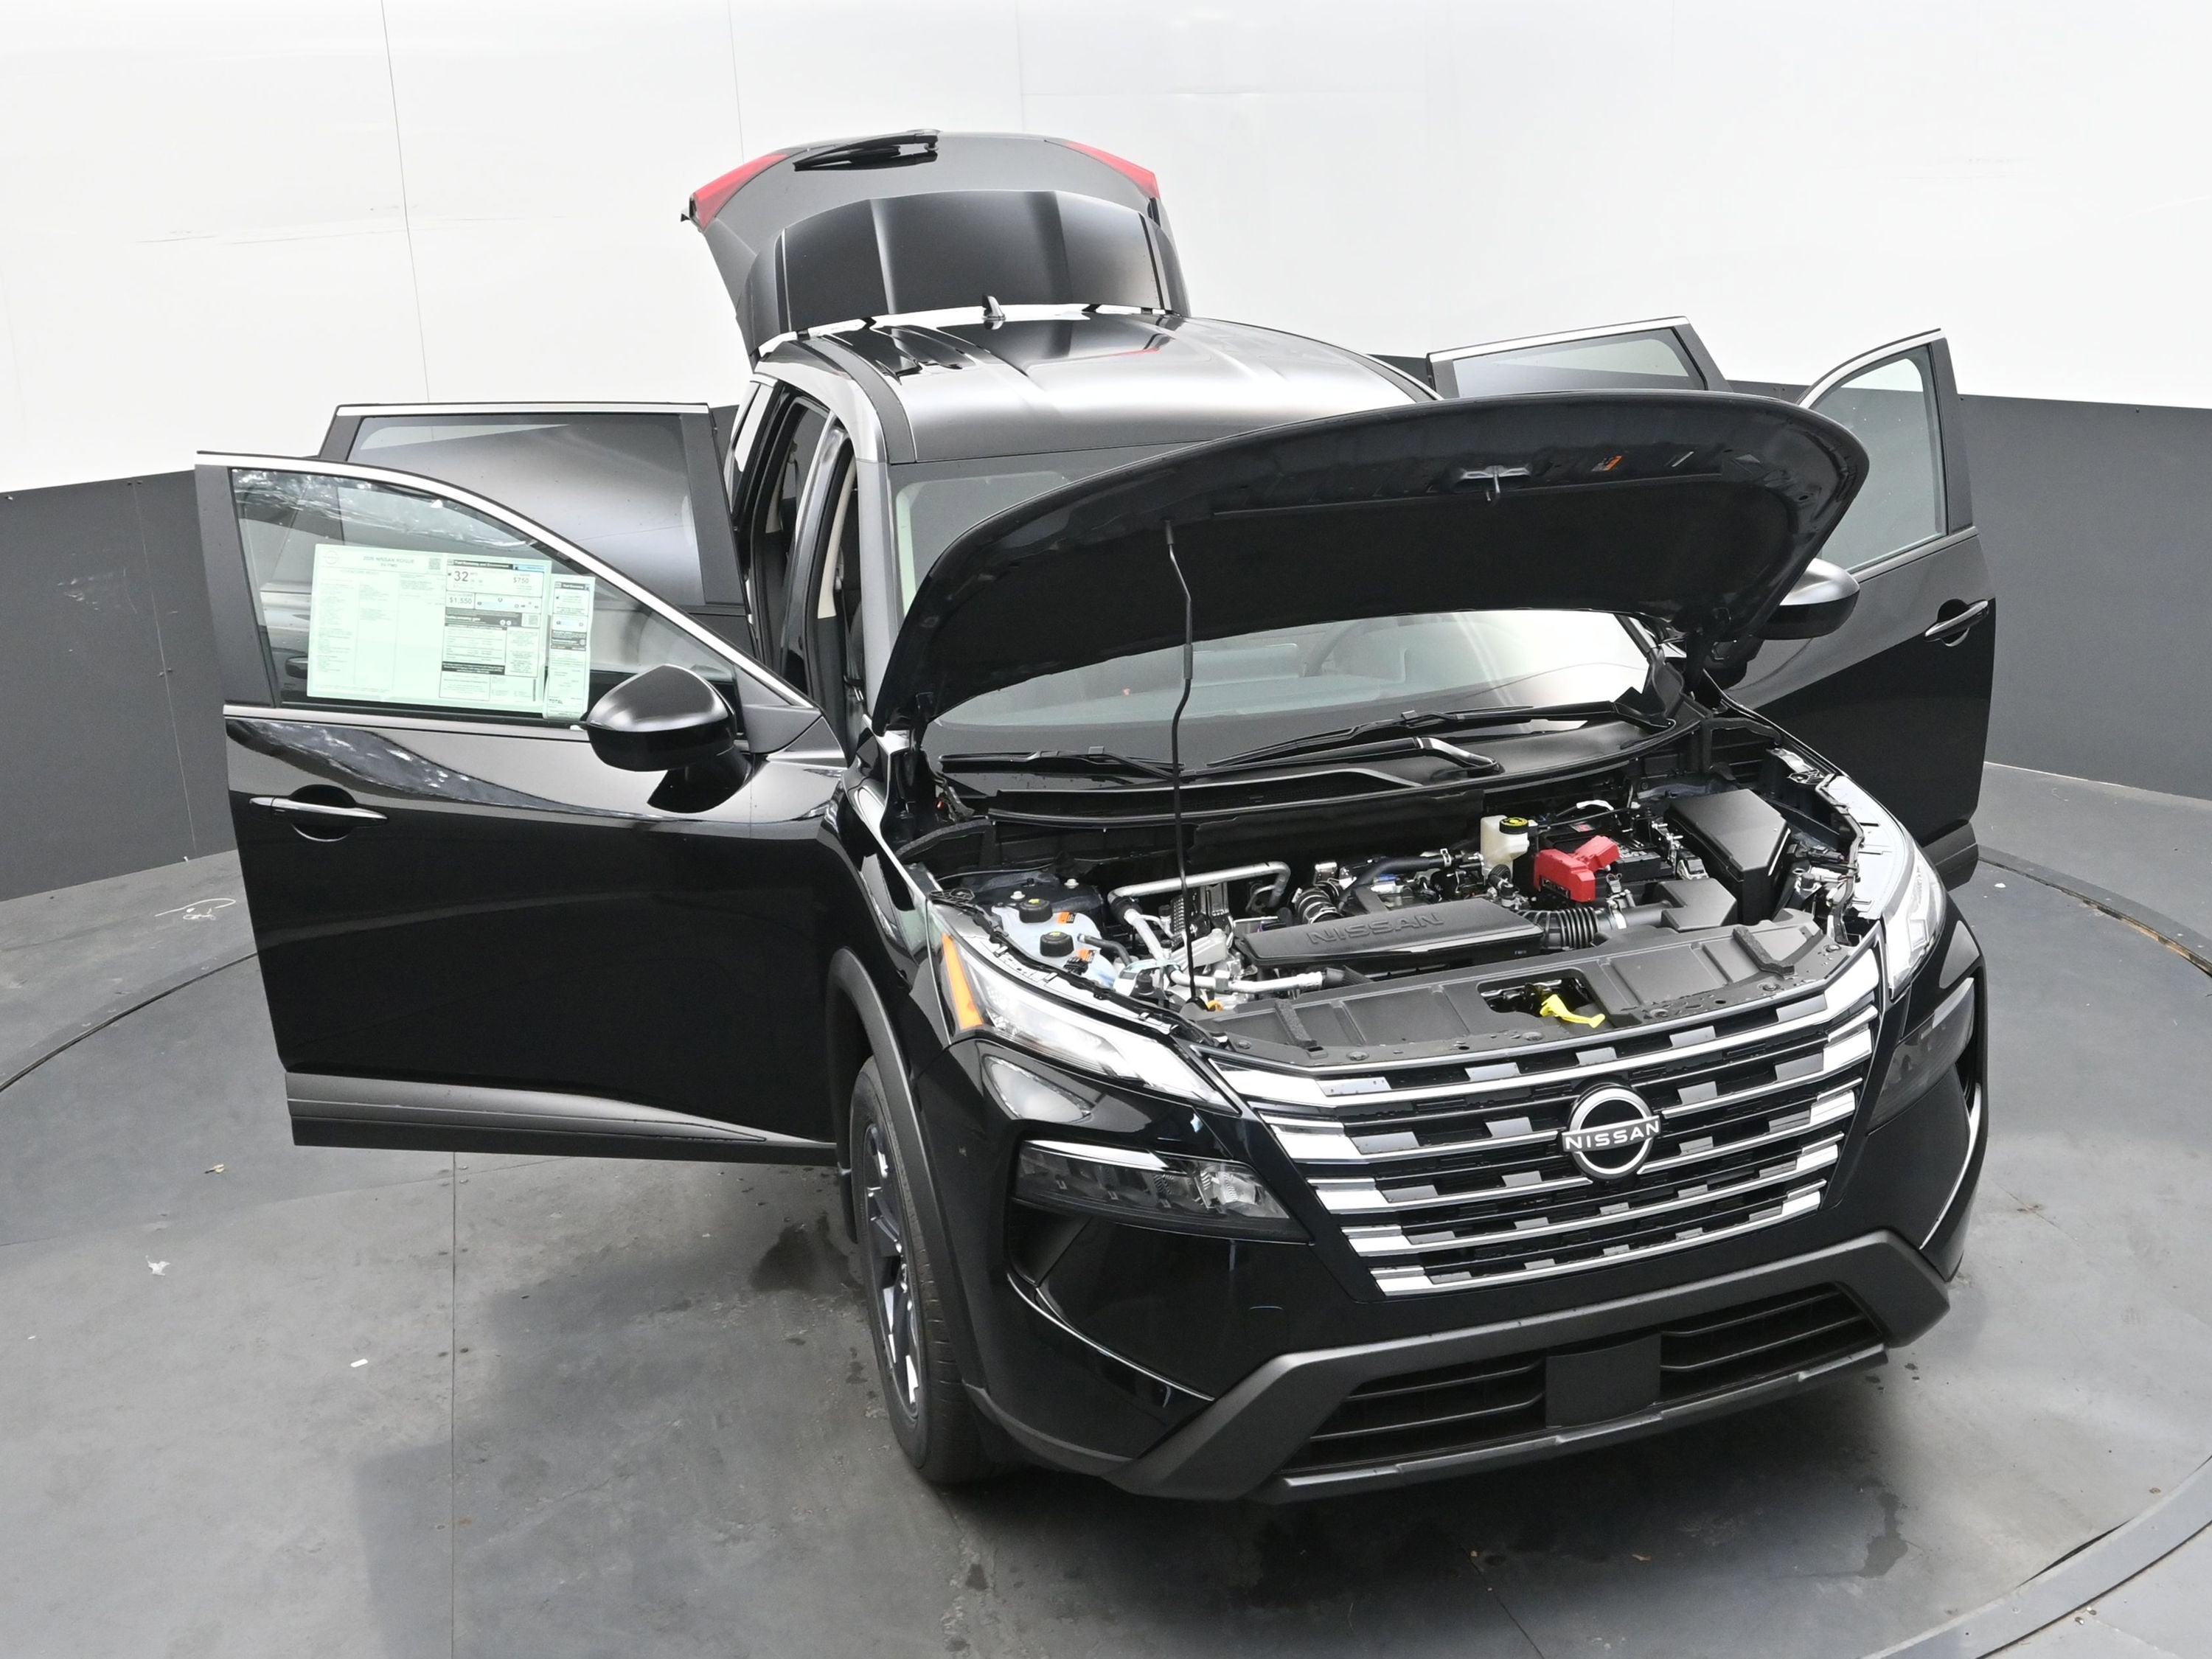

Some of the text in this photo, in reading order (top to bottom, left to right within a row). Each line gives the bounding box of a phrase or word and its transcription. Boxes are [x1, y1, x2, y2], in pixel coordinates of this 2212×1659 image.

[454, 571, 469, 582] 32
[449, 596, 473, 605] $1,550
[1306, 912, 1444, 945] NISSAN
[1565, 1120, 1659, 1150] NISSAN
